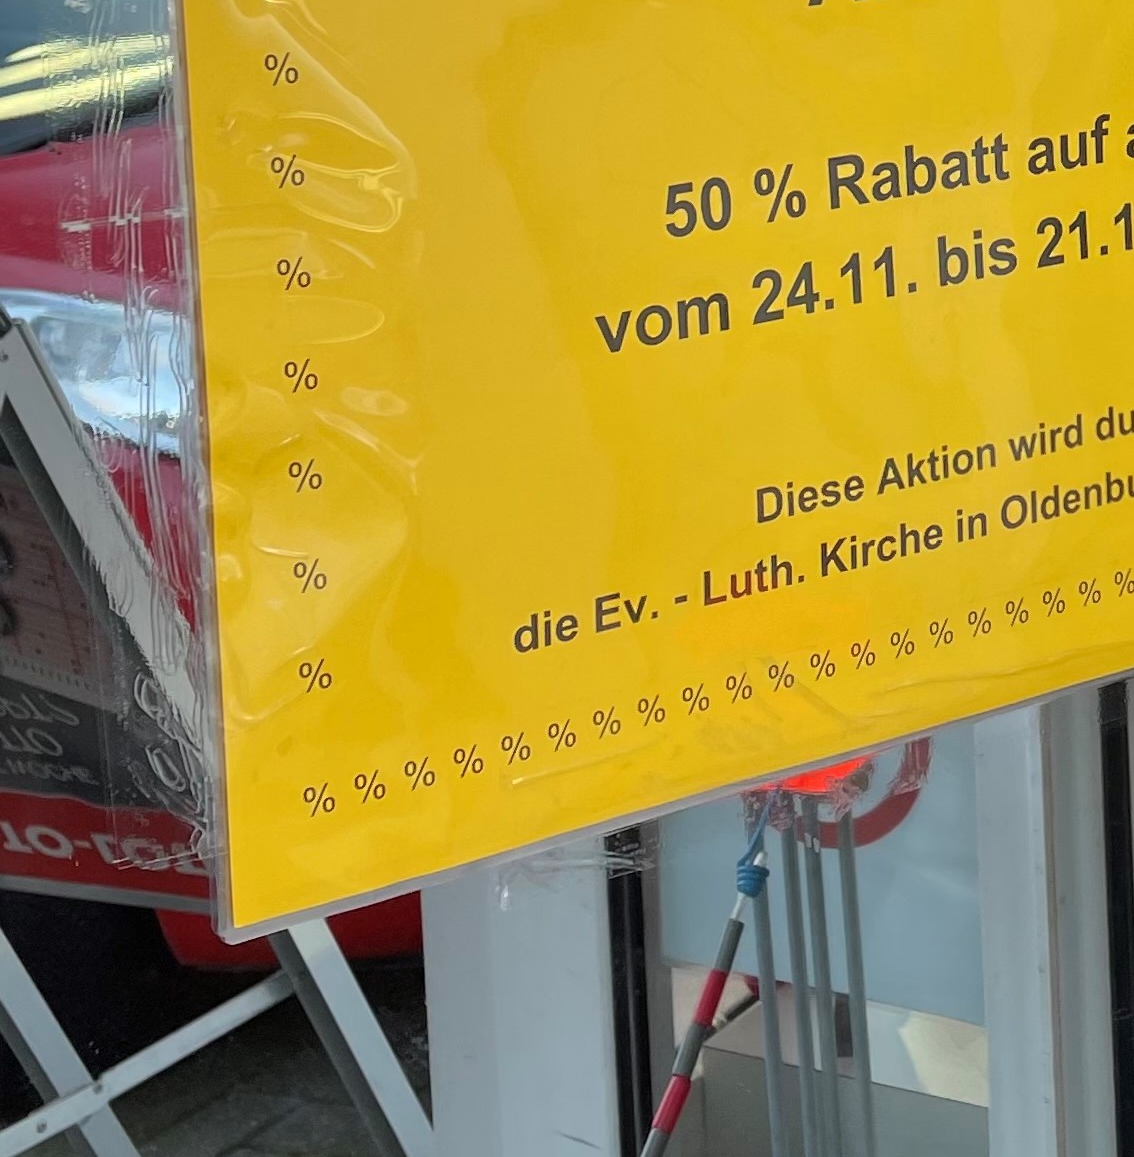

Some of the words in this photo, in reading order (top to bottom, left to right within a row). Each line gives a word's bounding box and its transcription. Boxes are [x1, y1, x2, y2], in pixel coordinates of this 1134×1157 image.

[665, 176, 732, 238] 50
[753, 163, 807, 224] %
[827, 132, 1011, 211] Rabatt
[1027, 113, 1111, 176] auf
[594, 292, 731, 354] vom
[751, 245, 918, 326] 24.11.
[936, 228, 1018, 288] bis
[756, 475, 865, 525] Diese
[876, 443, 997, 496] Aktion
[1007, 413, 1084, 462] wird
[513, 609, 579, 654] die
[594, 591, 659, 634] Ev.
[703, 553, 806, 607] Luth.
[820, 522, 944, 578] Kirche
[956, 508, 988, 544] in
